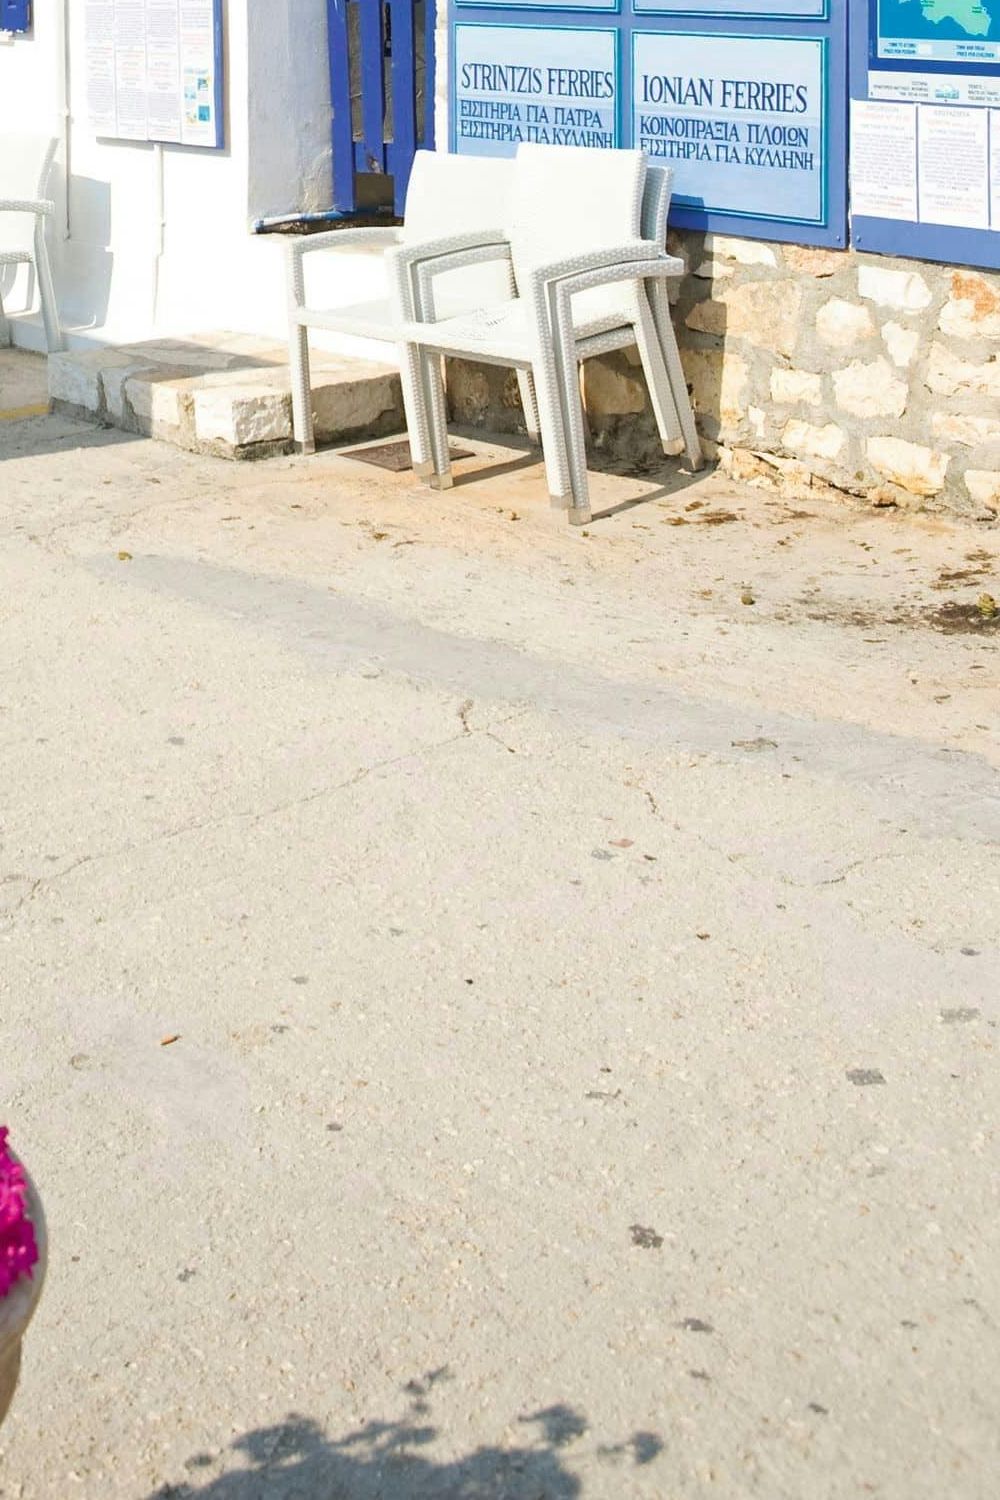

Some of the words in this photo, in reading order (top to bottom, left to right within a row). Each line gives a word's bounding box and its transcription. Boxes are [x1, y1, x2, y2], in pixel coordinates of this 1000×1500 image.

[461, 63, 542, 93] STRINTZIS
[546, 68, 614, 98] FERRIES
[642, 74, 713, 106] IONIAN
[720, 79, 808, 114] FERRIES
[460, 99, 521, 121] ΕΙΣΙΤΗΡΙΑ
[526, 104, 549, 124] ΓΙΑ
[554, 107, 603, 128] ΠΑΤΡΑ
[460, 119, 524, 142] ΕΙΣΙΤΗΡΙΑ
[527, 125, 550, 145] ΓΙΑ
[552, 127, 614, 149] ΚΥΛΛΗΝΗ
[639, 115, 740, 142] ΚΟΙΝΟΠΡΑΞΙΑ
[746, 123, 809, 148] ΠΛΟΙΩΝ
[639, 137, 713, 161] ΕΙΣΙΤΗΡΙΑ
[715, 144, 740, 165] ΓΙΑ
[744, 146, 814, 170] ΚΥΛΛΗΝΗ
